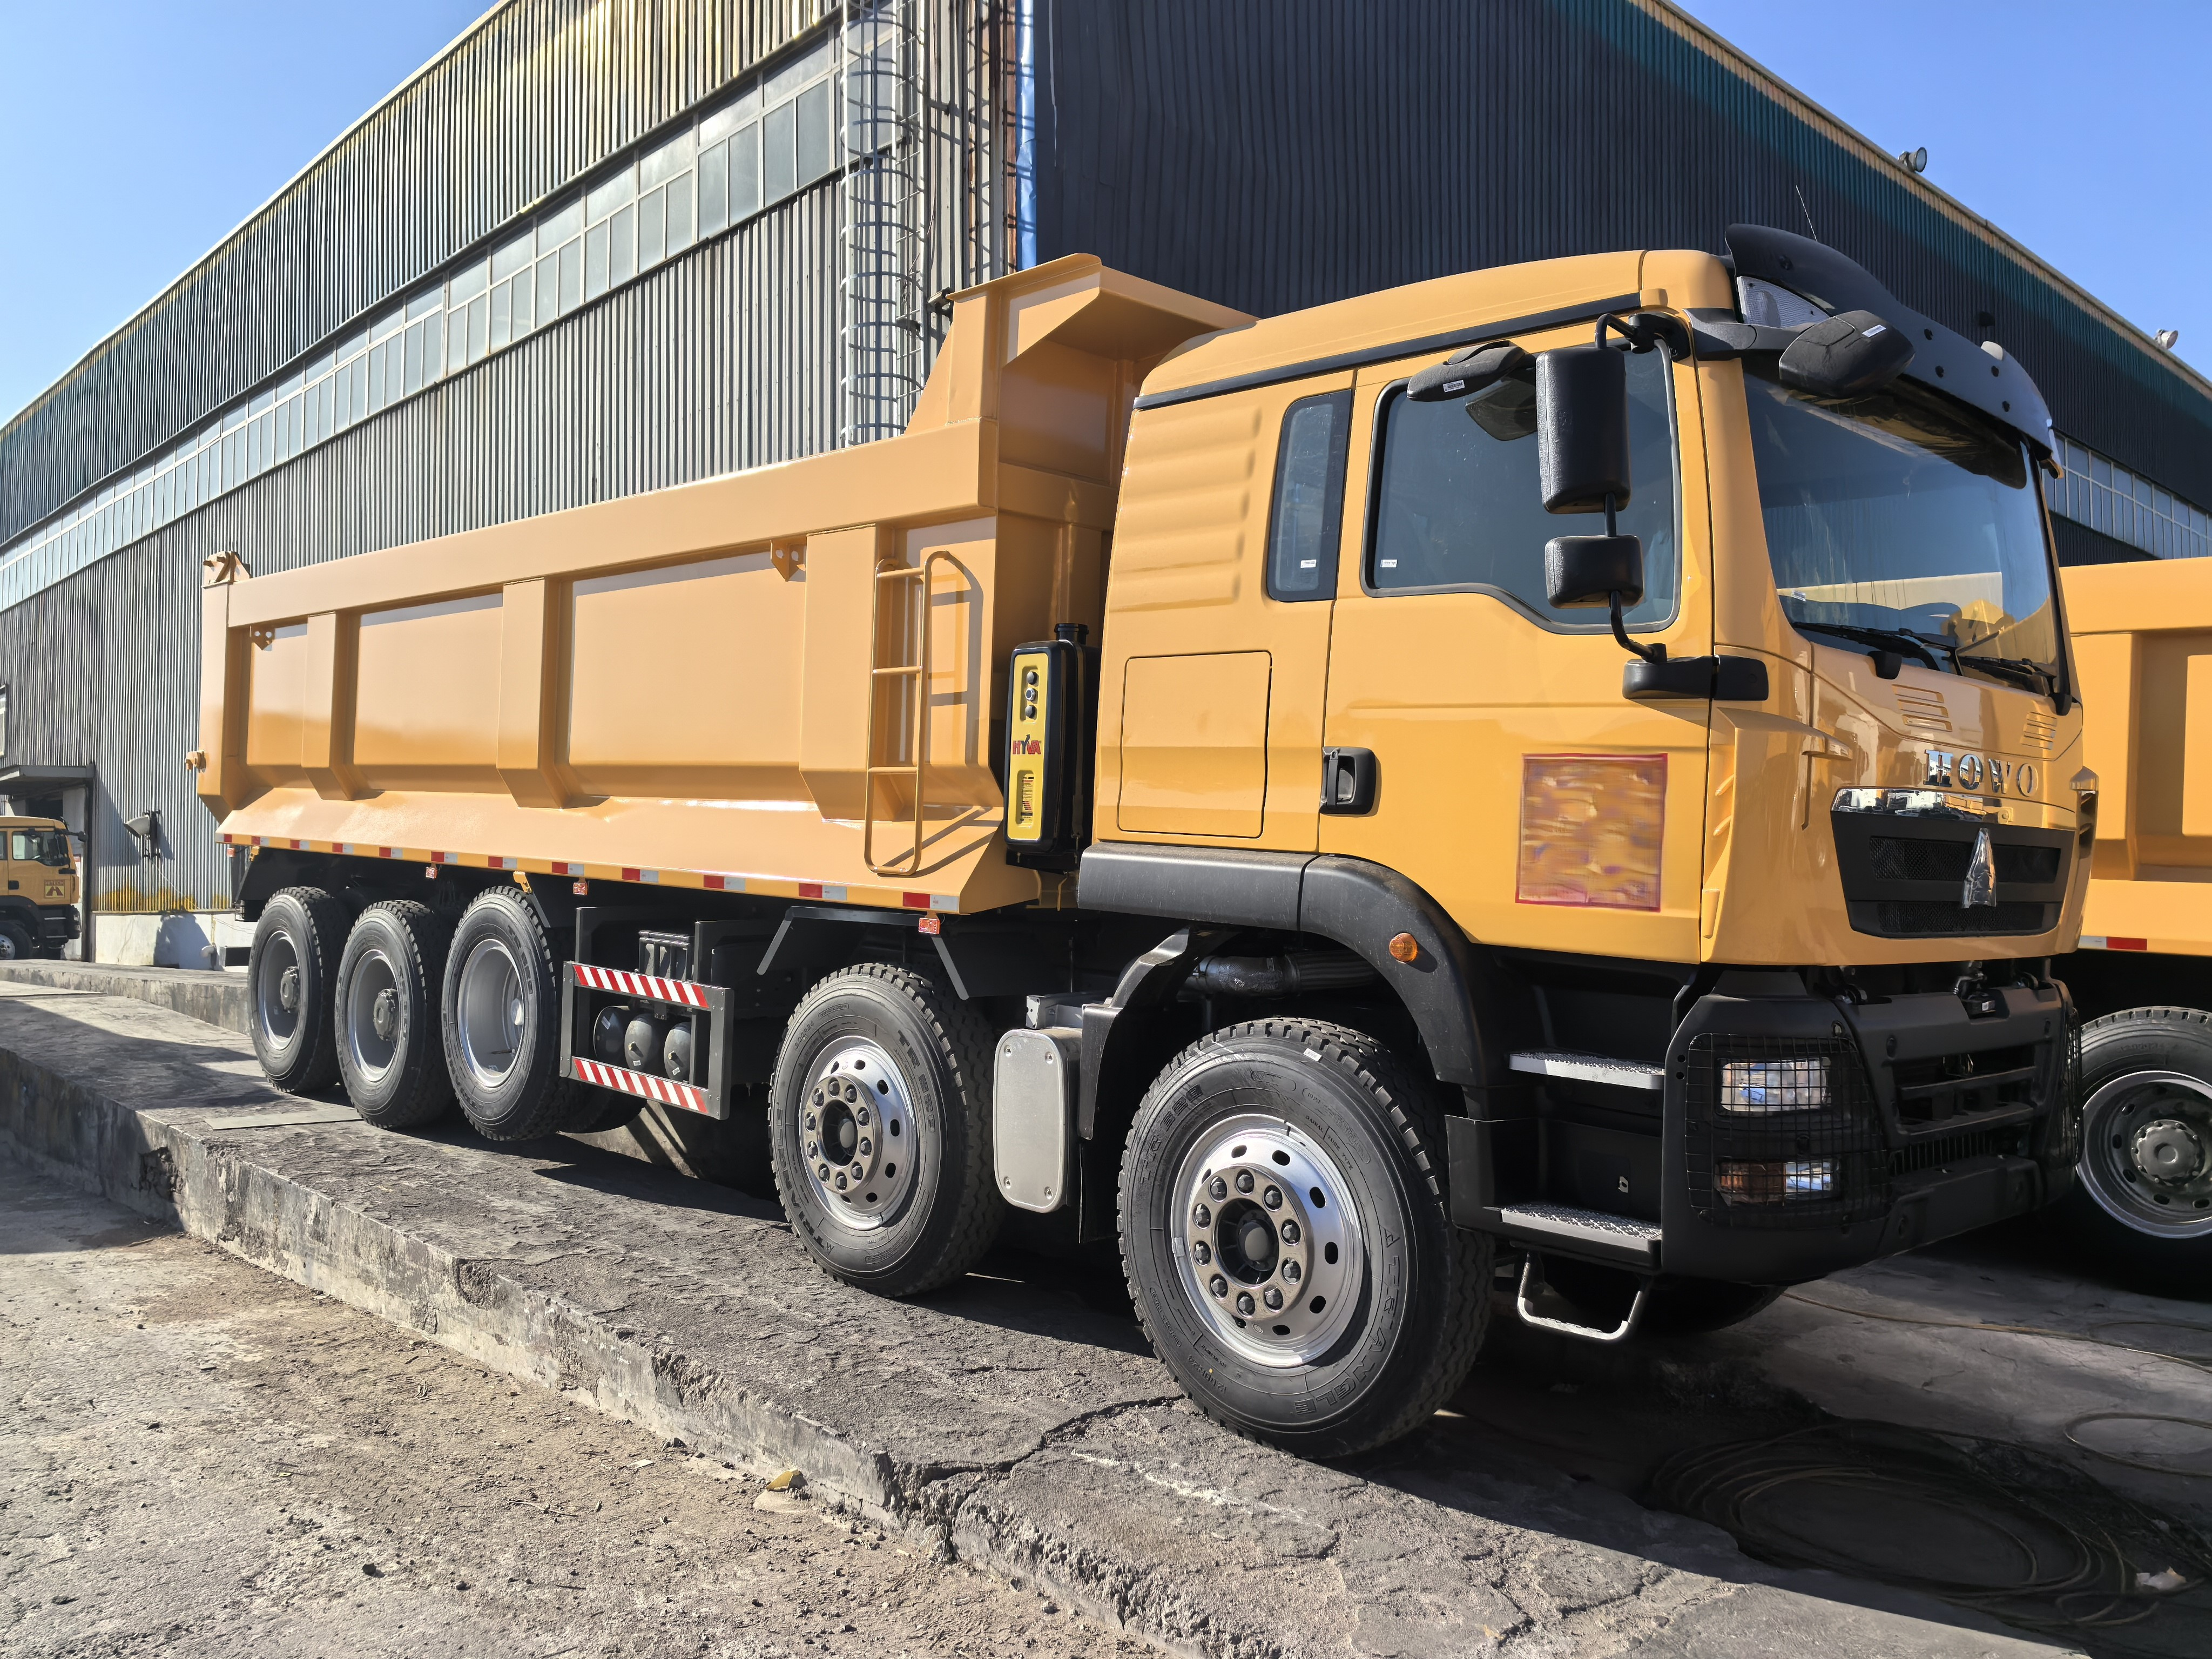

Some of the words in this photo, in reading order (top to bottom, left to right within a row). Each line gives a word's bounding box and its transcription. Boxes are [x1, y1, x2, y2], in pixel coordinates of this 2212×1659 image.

[1013, 734, 1041, 754] HYVA
[1923, 749, 2039, 797] HOWO
[898, 1029, 920, 1069] TR
[1139, 1135, 1162, 1185] TR
[1327, 1135, 1340, 1151] TUBE
[1341, 1152, 1354, 1170] TYPE
[777, 1108, 825, 1250] TRIANGLE
[1294, 1255, 1400, 1415] TRIANGLE
